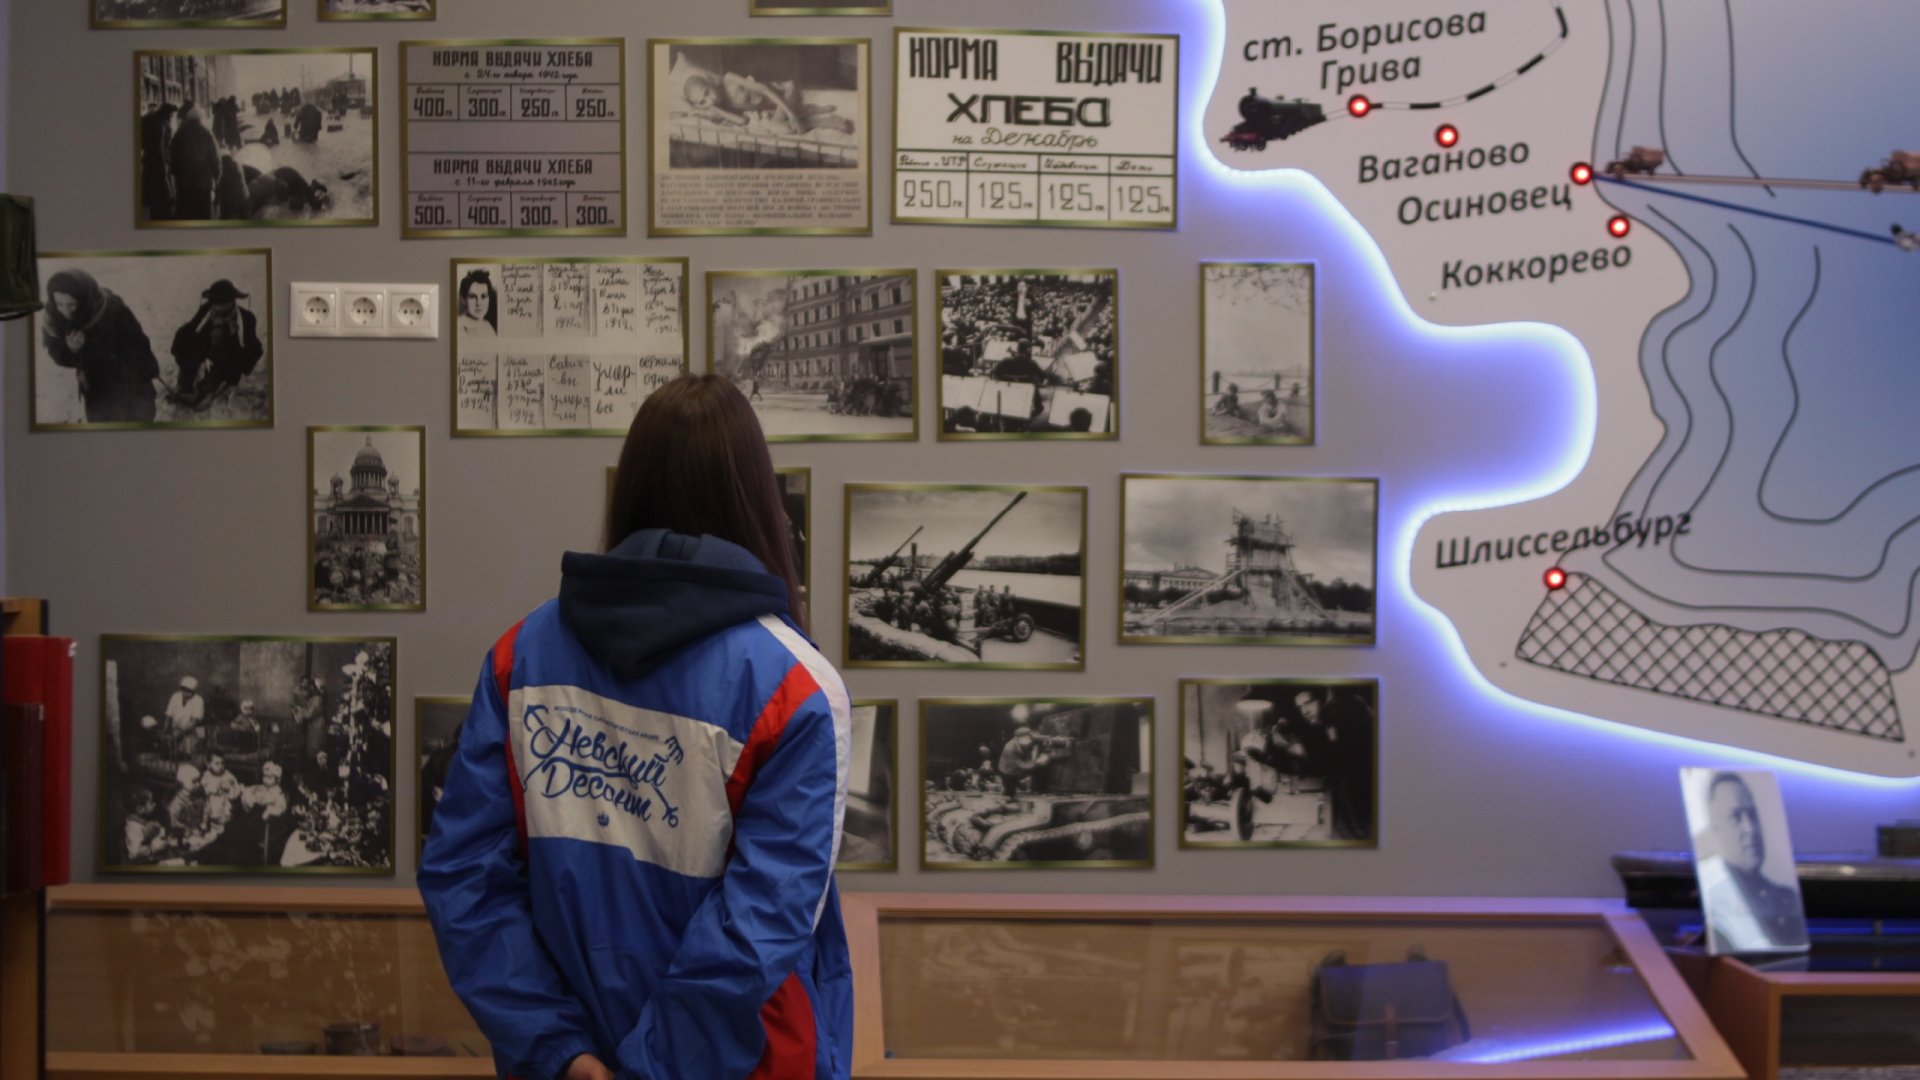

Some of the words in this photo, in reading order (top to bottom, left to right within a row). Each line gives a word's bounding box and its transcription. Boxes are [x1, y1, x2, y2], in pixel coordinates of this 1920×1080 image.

[1243, 35, 1302, 62] ст.
[1316, 11, 1487, 53] Борисова
[433, 51, 479, 67] НОРМА
[486, 51, 542, 68] ВЫДАЧИ
[547, 51, 593, 67] ХЛЕБА
[909, 37, 998, 81] НОРМА
[1055, 41, 1164, 86] ВЫДАЧИ
[1320, 56, 1421, 94] Грива
[946, 93, 1111, 127] ХЛЕБА
[952, 134, 974, 145] на
[981, 127, 1098, 150] Декабрь
[433, 159, 479, 174] НОРМА
[486, 159, 542, 175] ВЫДАЧИ
[548, 159, 593, 174] ХЛЕБА
[1358, 141, 1530, 183] Ваганово
[1397, 182, 1572, 225] Осиновец
[1442, 245, 1632, 289] Коккорево
[1435, 512, 1692, 569] Шлиссельбург
[531, 717, 669, 789] Невский
[540, 757, 652, 822] Десант
